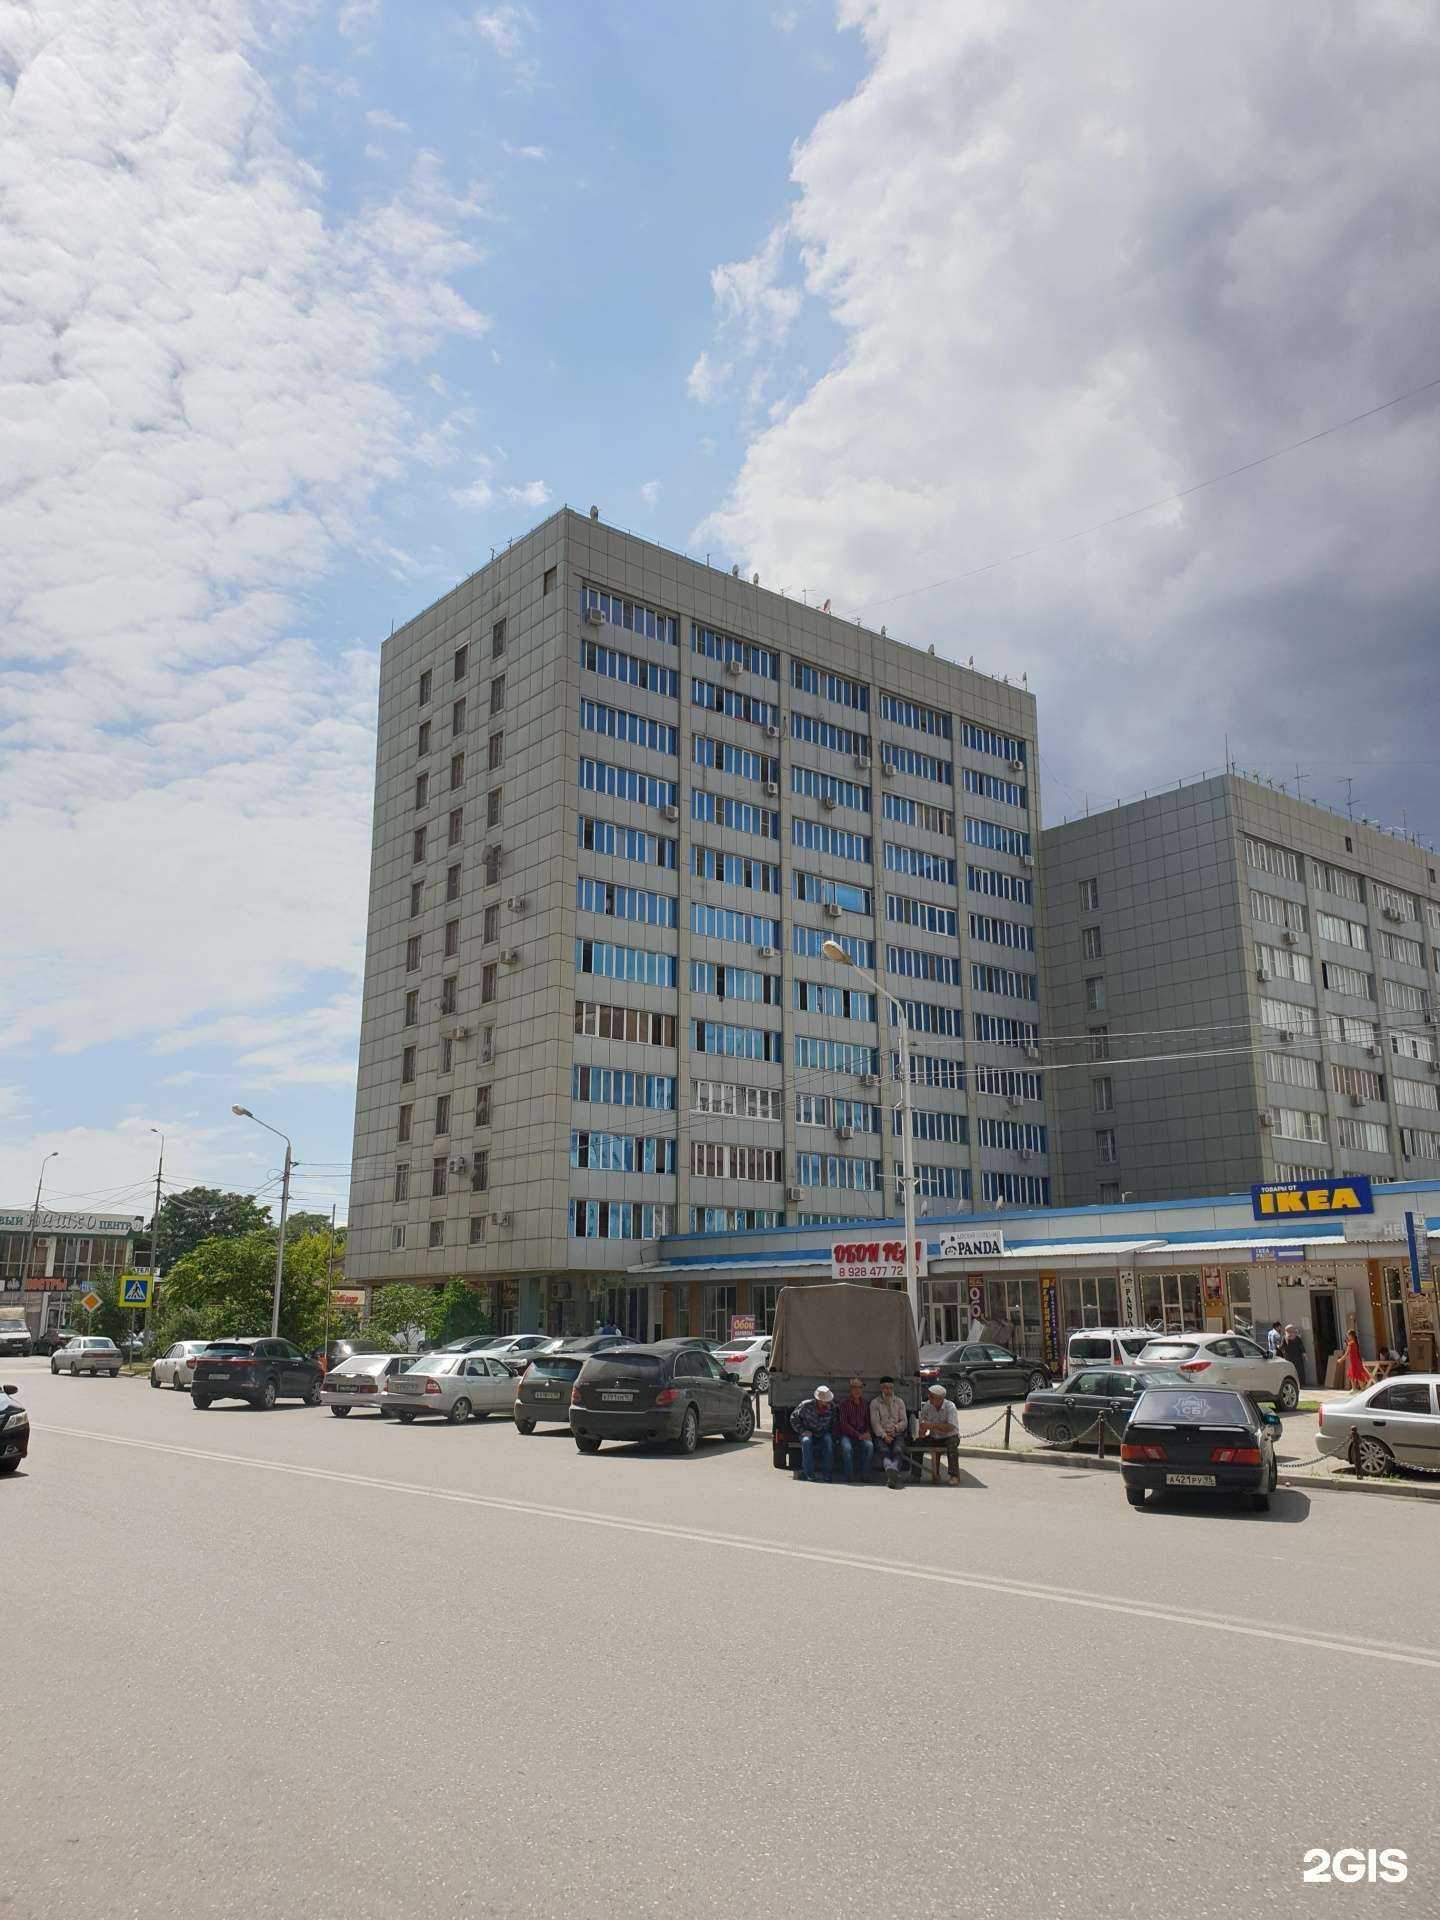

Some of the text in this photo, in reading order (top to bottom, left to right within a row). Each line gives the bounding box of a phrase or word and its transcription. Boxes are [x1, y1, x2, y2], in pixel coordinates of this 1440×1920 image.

[1260, 1187, 1361, 1214] IKEA
[958, 1240, 1001, 1256] PANDA
[839, 1267, 846, 1277] 8
[849, 1266, 867, 1277] 928
[870, 1266, 887, 1276] 477
[891, 1265, 904, 1276] 72
[1125, 1288, 1133, 1327] PANDA
